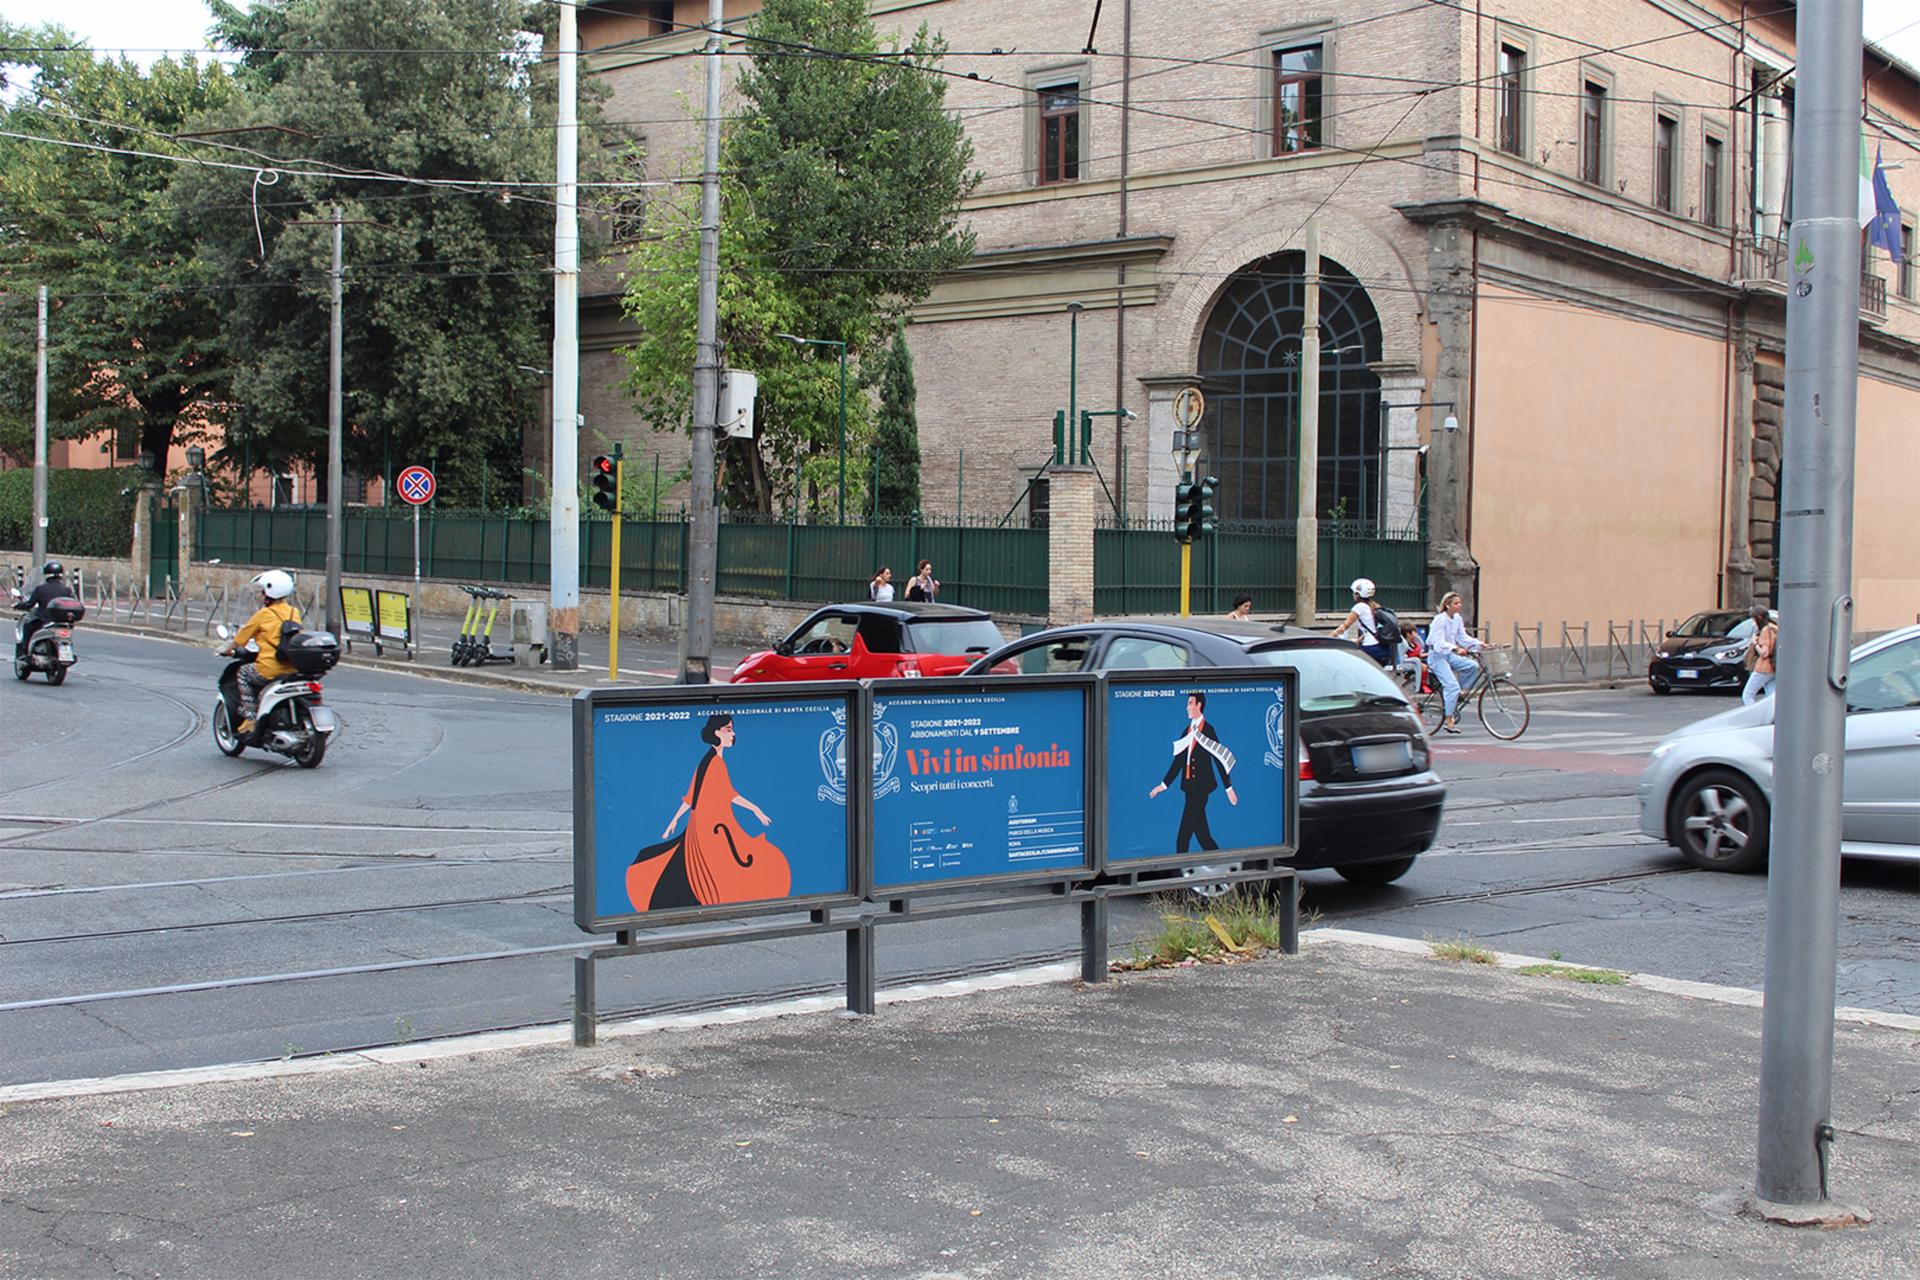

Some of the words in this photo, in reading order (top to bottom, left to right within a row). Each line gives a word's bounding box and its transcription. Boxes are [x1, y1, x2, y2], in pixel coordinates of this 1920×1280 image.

[1114, 690, 1142, 698] STAGIONE
[1143, 689, 1175, 697] 2021-2022
[604, 713, 643, 722] STAGIONE
[644, 711, 691, 721] 2021-2022
[697, 709, 735, 717] ACCADEMIA
[910, 719, 942, 728] STAGIONE
[943, 718, 982, 727] 2021-2022
[910, 729, 960, 739] ABBONAMENTI
[960, 729, 973, 737] DAL
[973, 728, 979, 736] 9
[980, 726, 1020, 736] SETTEMBRE
[905, 748, 951, 776] Vivi
[955, 747, 978, 774] in
[981, 743, 1071, 772] sinfonia
[910, 780, 938, 794] Scopri
[939, 780, 956, 791] tutti
[957, 779, 960, 790] i
[960, 778, 994, 789] concerti.
